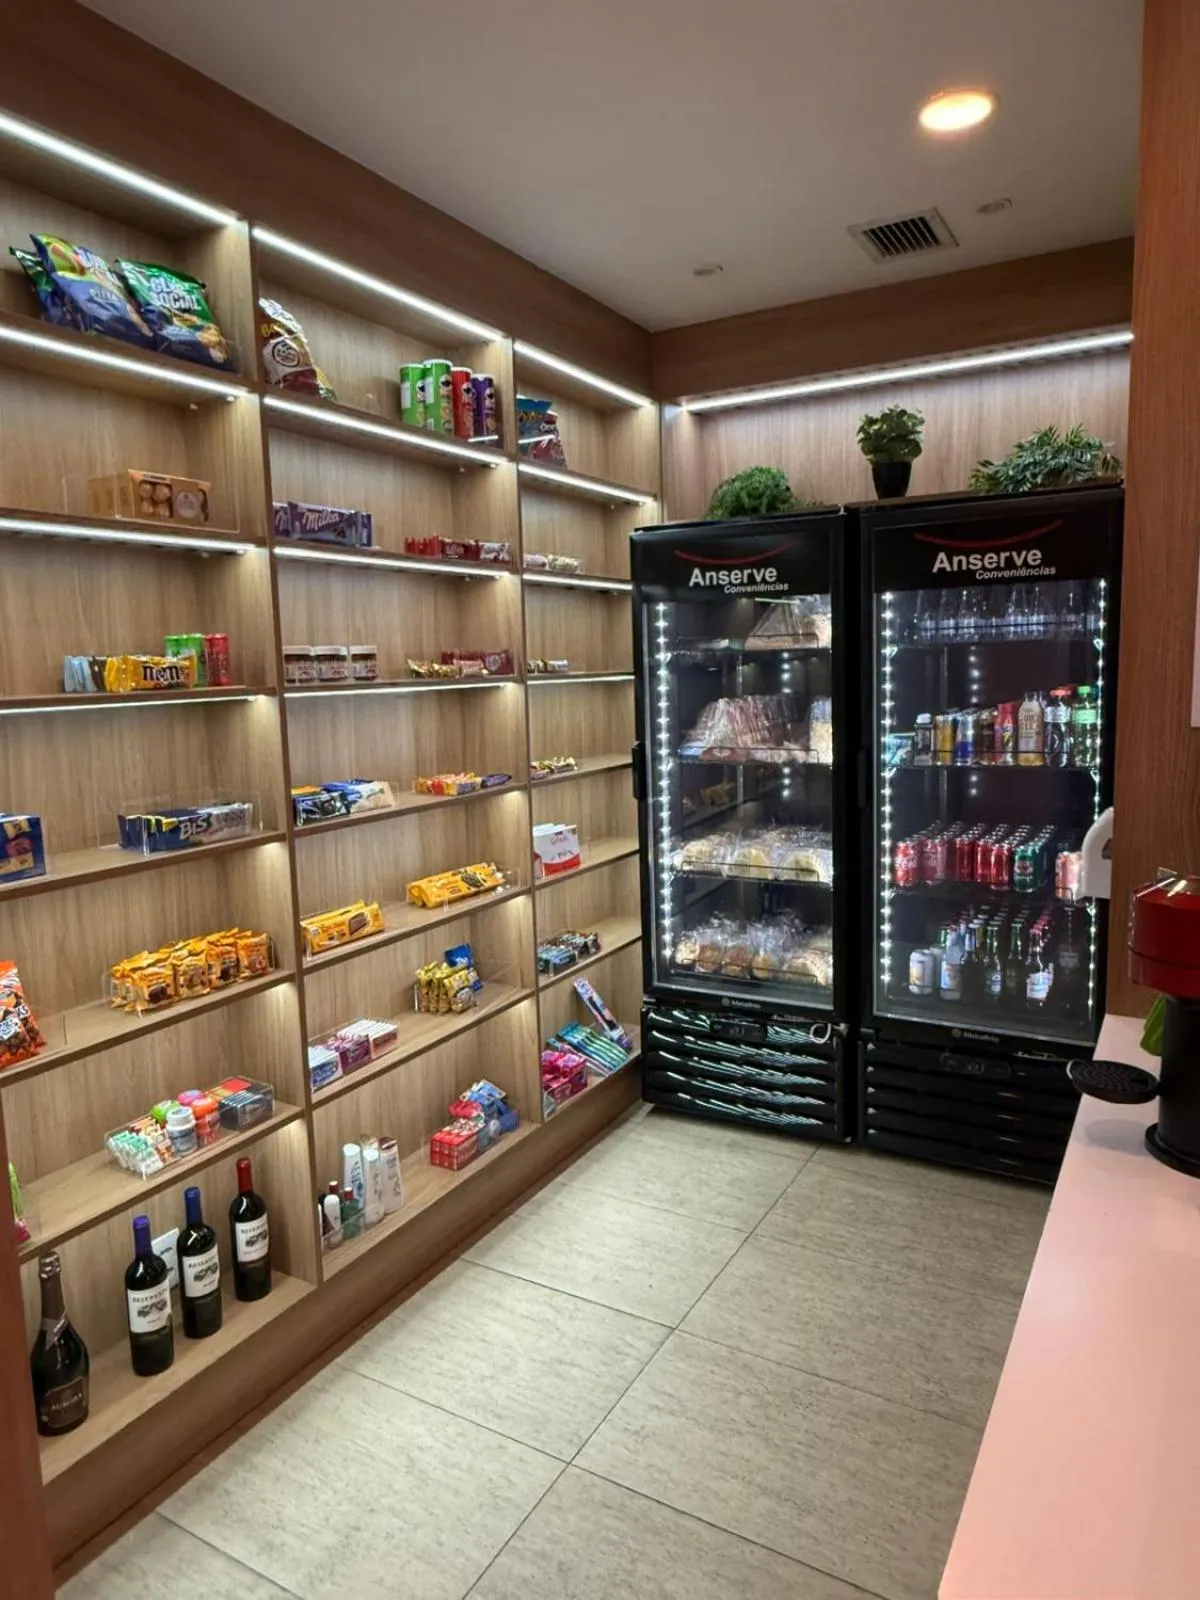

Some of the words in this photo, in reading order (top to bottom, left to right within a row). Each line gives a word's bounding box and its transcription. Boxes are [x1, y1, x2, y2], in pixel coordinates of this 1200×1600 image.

[302, 508, 340, 531] Milka
[932, 548, 1042, 573] Anserve
[689, 566, 778, 587] Anserve
[975, 565, 1056, 580] Conveniências
[724, 581, 789, 594] Conveniências
